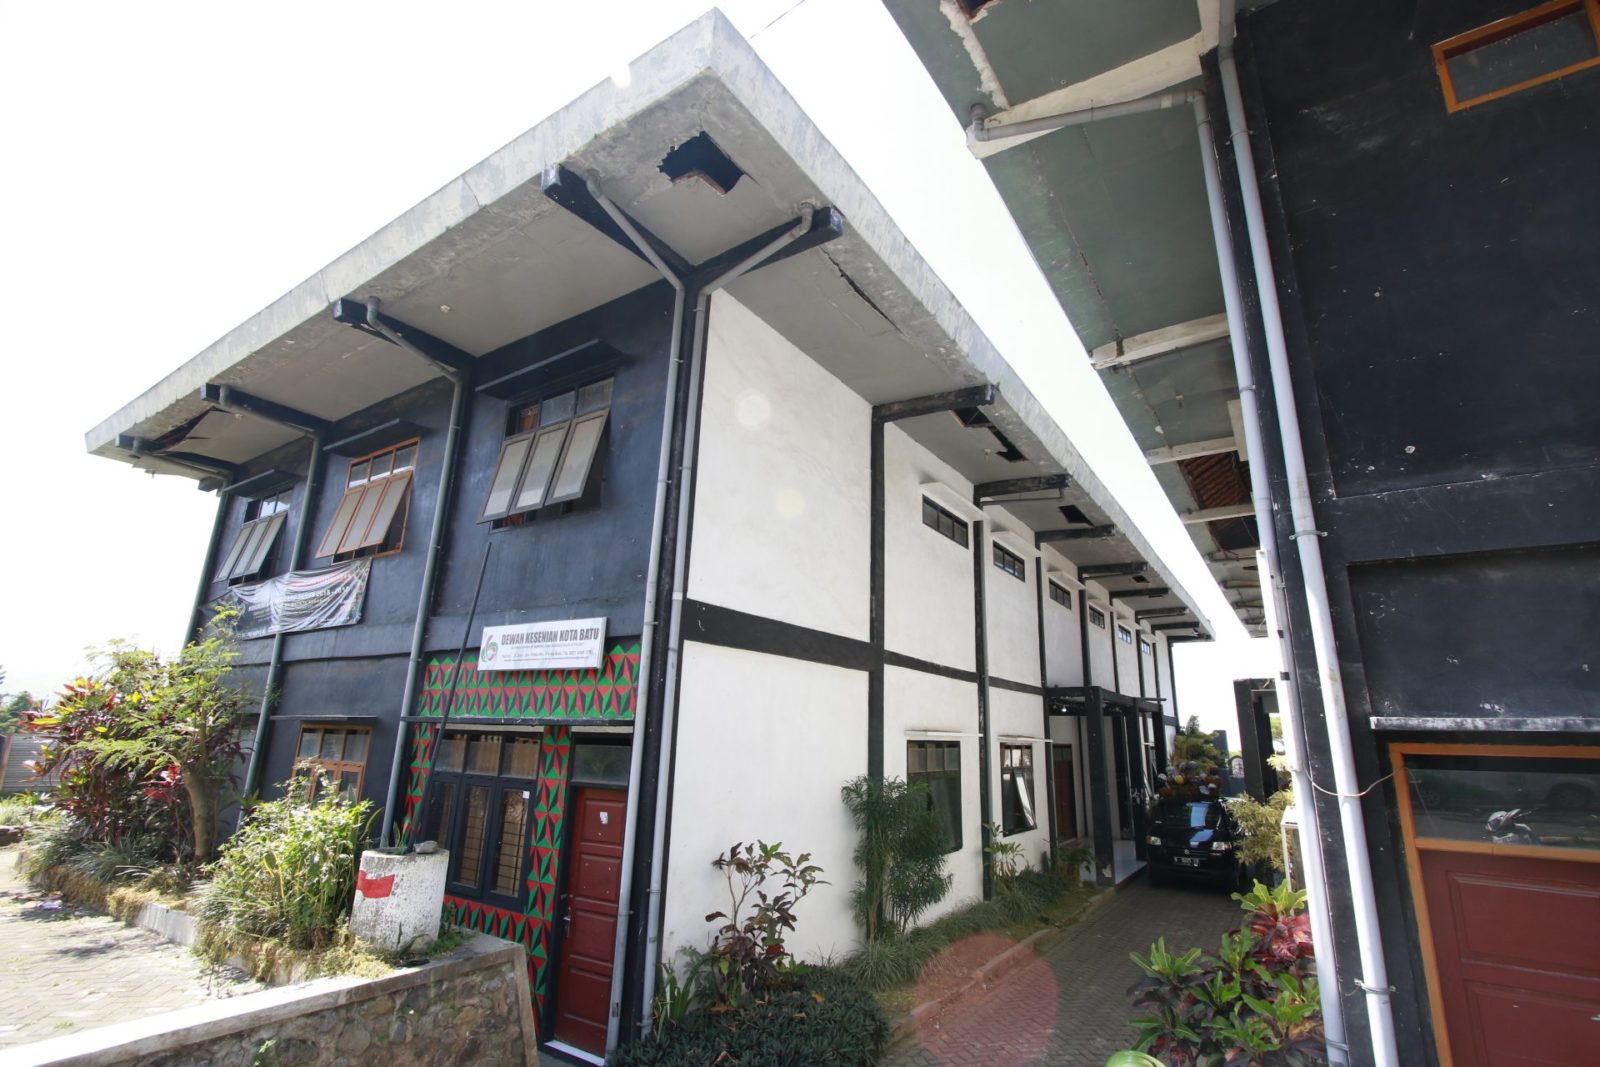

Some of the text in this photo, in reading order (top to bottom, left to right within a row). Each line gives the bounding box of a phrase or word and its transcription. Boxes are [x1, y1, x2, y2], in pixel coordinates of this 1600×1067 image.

[501, 627, 600, 645] DEWAN KESENIAN KOTA BATU
